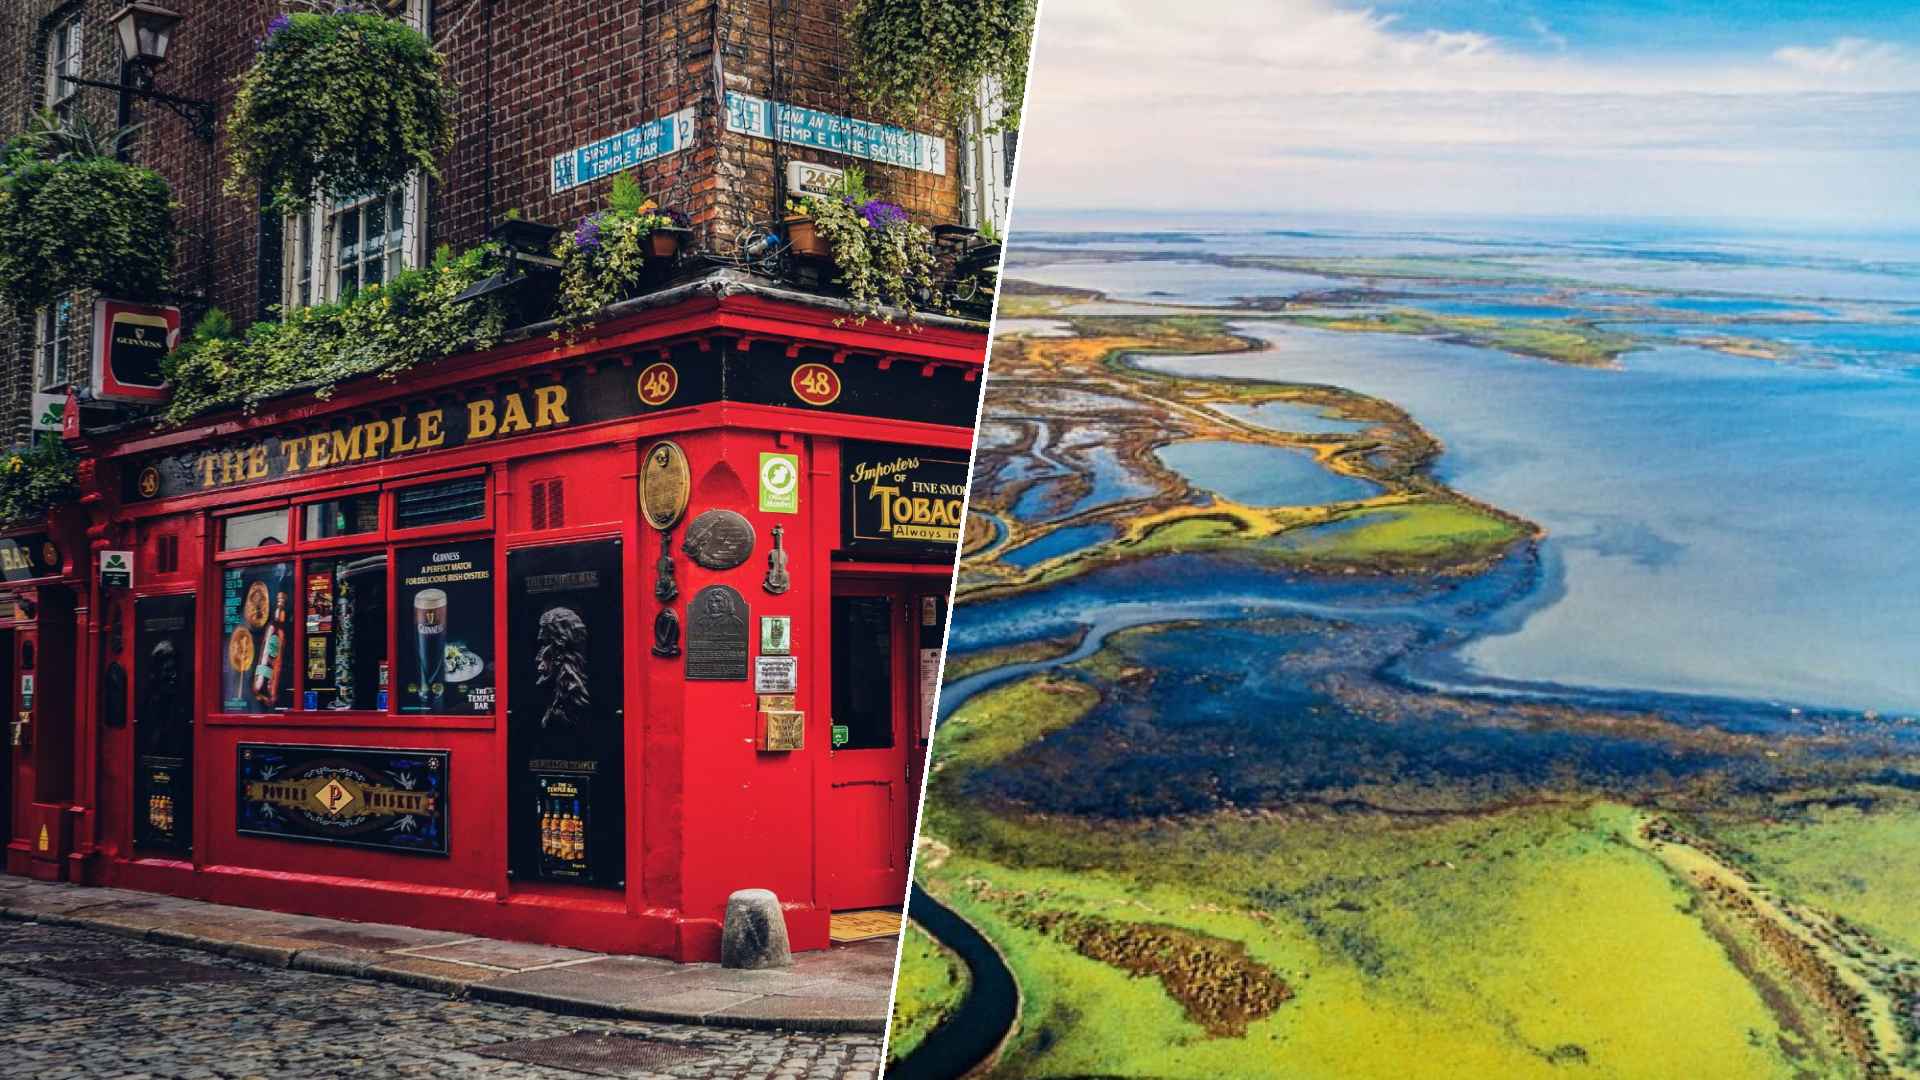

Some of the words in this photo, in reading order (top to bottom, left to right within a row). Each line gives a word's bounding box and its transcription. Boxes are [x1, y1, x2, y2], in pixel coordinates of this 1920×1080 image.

[681, 120, 689, 138] 2
[808, 115, 823, 129] AN
[777, 124, 827, 145] TEMPE
[592, 150, 632, 175] TEMPLE
[117, 337, 162, 348] GUINNESS
[644, 372, 670, 397] 48
[801, 368, 831, 395] 48
[199, 449, 268, 487] THE
[282, 409, 445, 471] TEMPLE
[467, 383, 570, 439] BAR
[849, 457, 920, 486] Importers
[894, 474, 907, 482] OF
[912, 481, 938, 493] FINE
[896, 525, 941, 539] Always
[0, 547, 35, 570] BAR
[433, 552, 461, 562] GUINNESS
[427, 563, 450, 573] PERFECT
[452, 562, 472, 570] MATCH
[417, 574, 447, 584] DELICIOUS
[474, 702, 488, 710] BAR
[363, 789, 422, 810] WHISKEY
